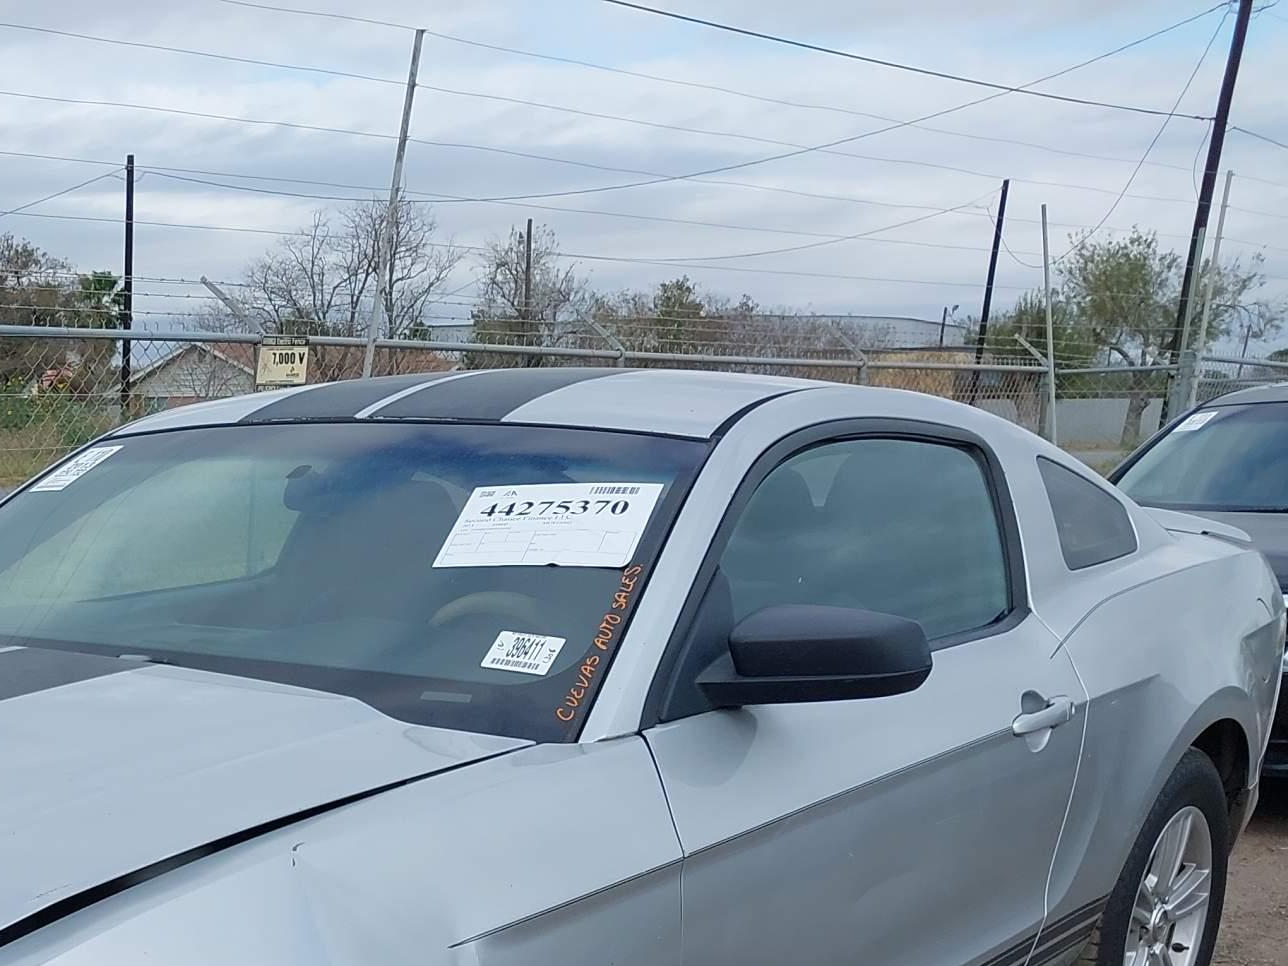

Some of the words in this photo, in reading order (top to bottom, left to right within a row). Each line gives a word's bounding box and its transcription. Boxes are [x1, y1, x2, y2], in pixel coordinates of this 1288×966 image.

[272, 351, 296, 367] 7,000
[298, 351, 306, 365] V
[480, 500, 629, 517] 44275370
[506, 637, 547, 661] 396411
[556, 655, 600, 721] CUEVAS
[593, 614, 621, 650] AUTO
